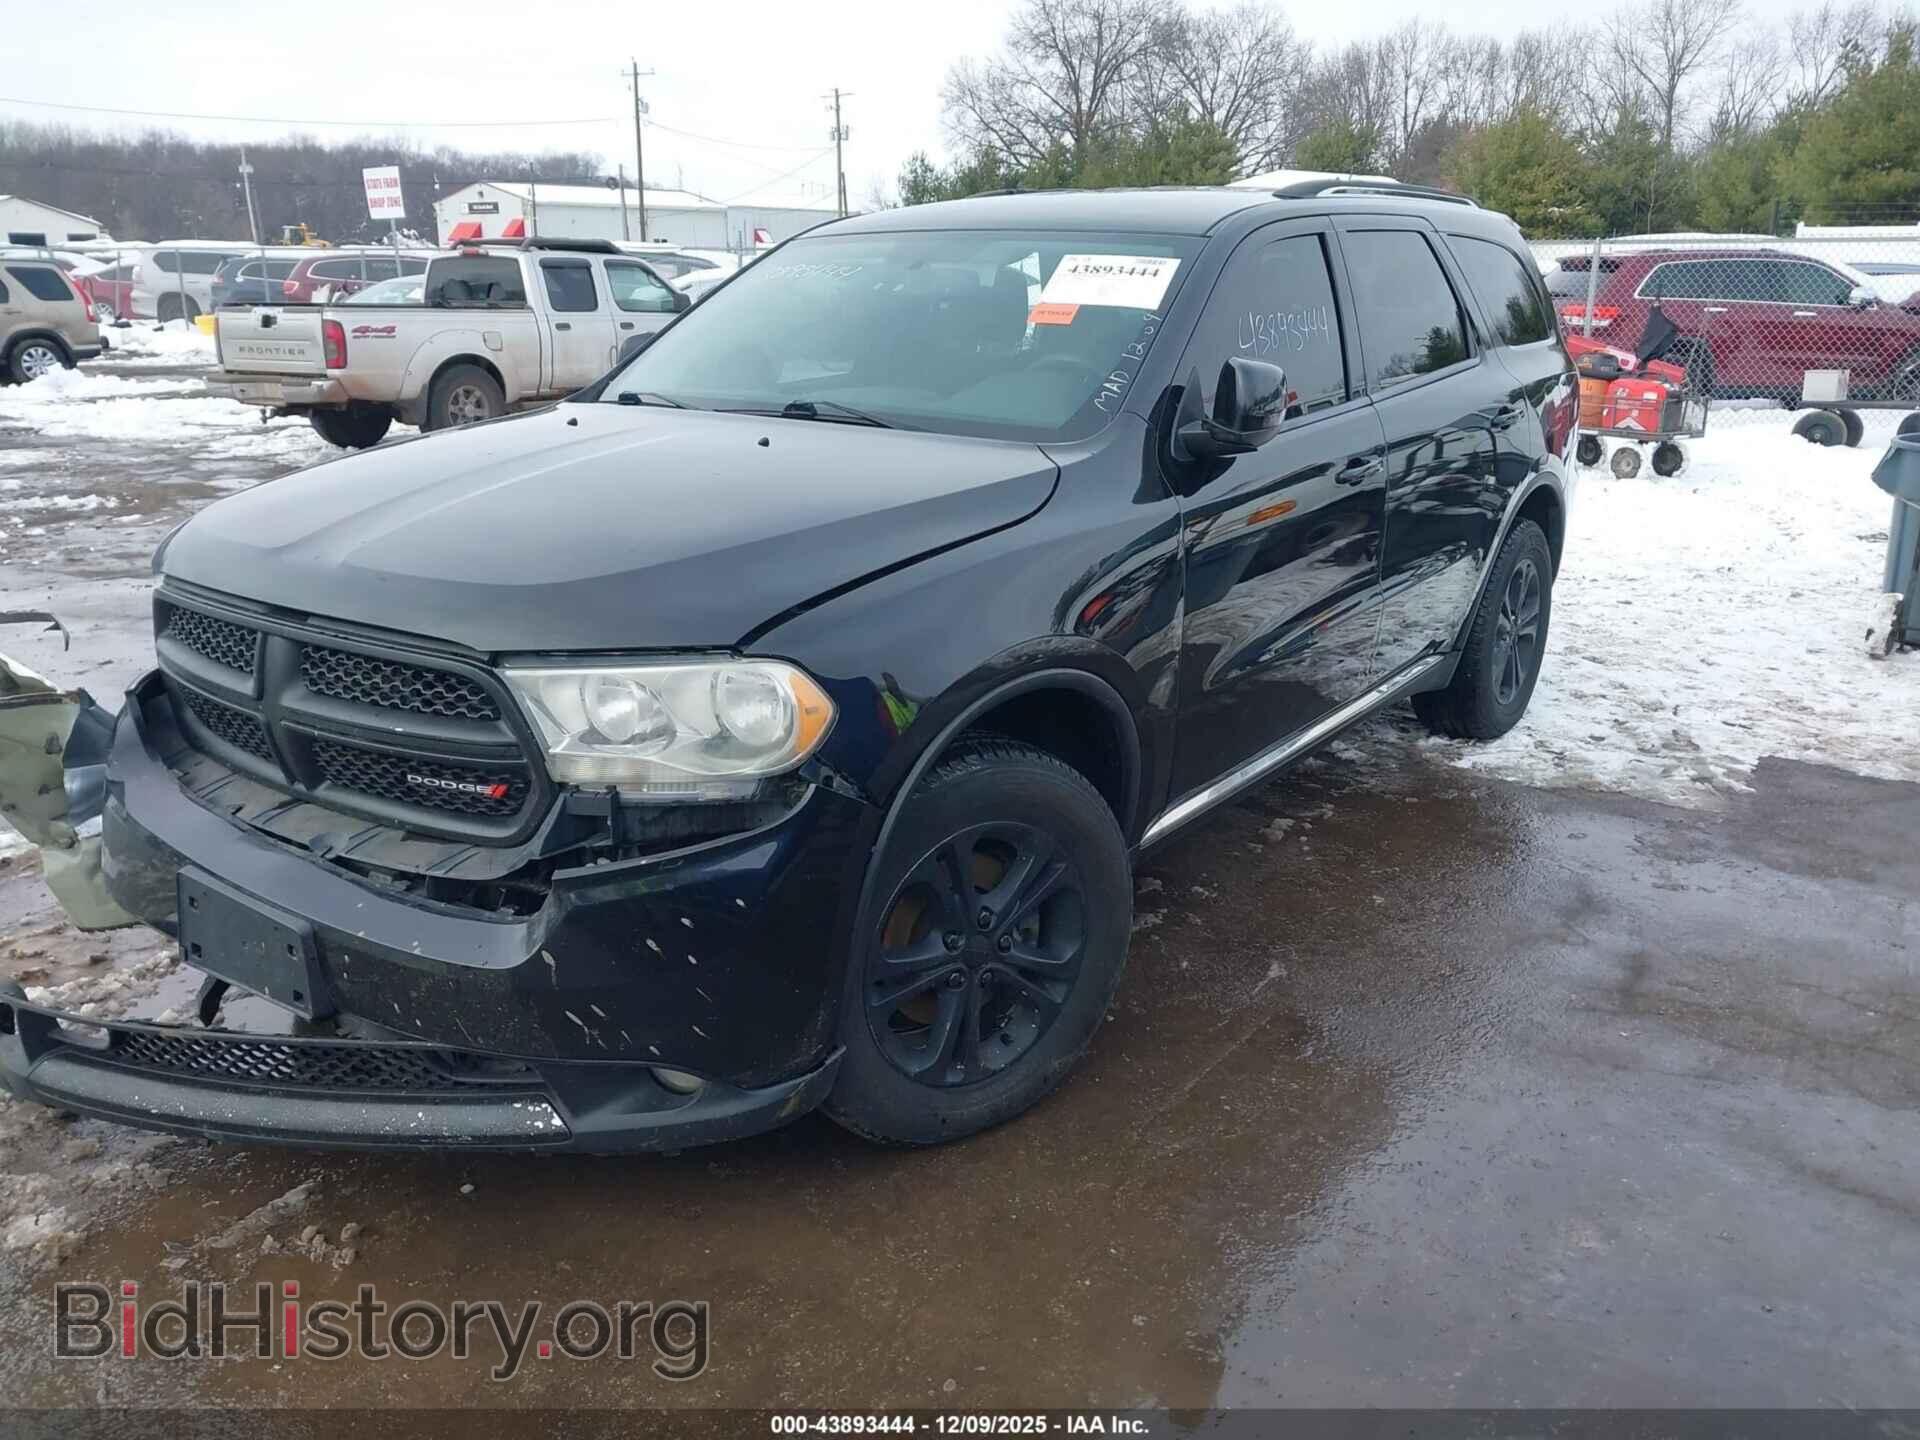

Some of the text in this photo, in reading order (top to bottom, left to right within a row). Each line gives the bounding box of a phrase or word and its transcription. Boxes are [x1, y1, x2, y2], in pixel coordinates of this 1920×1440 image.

[1067, 264, 1160, 278] 43893444
[238, 345, 306, 355] FRONTIER
[407, 774, 490, 794] DODGE
